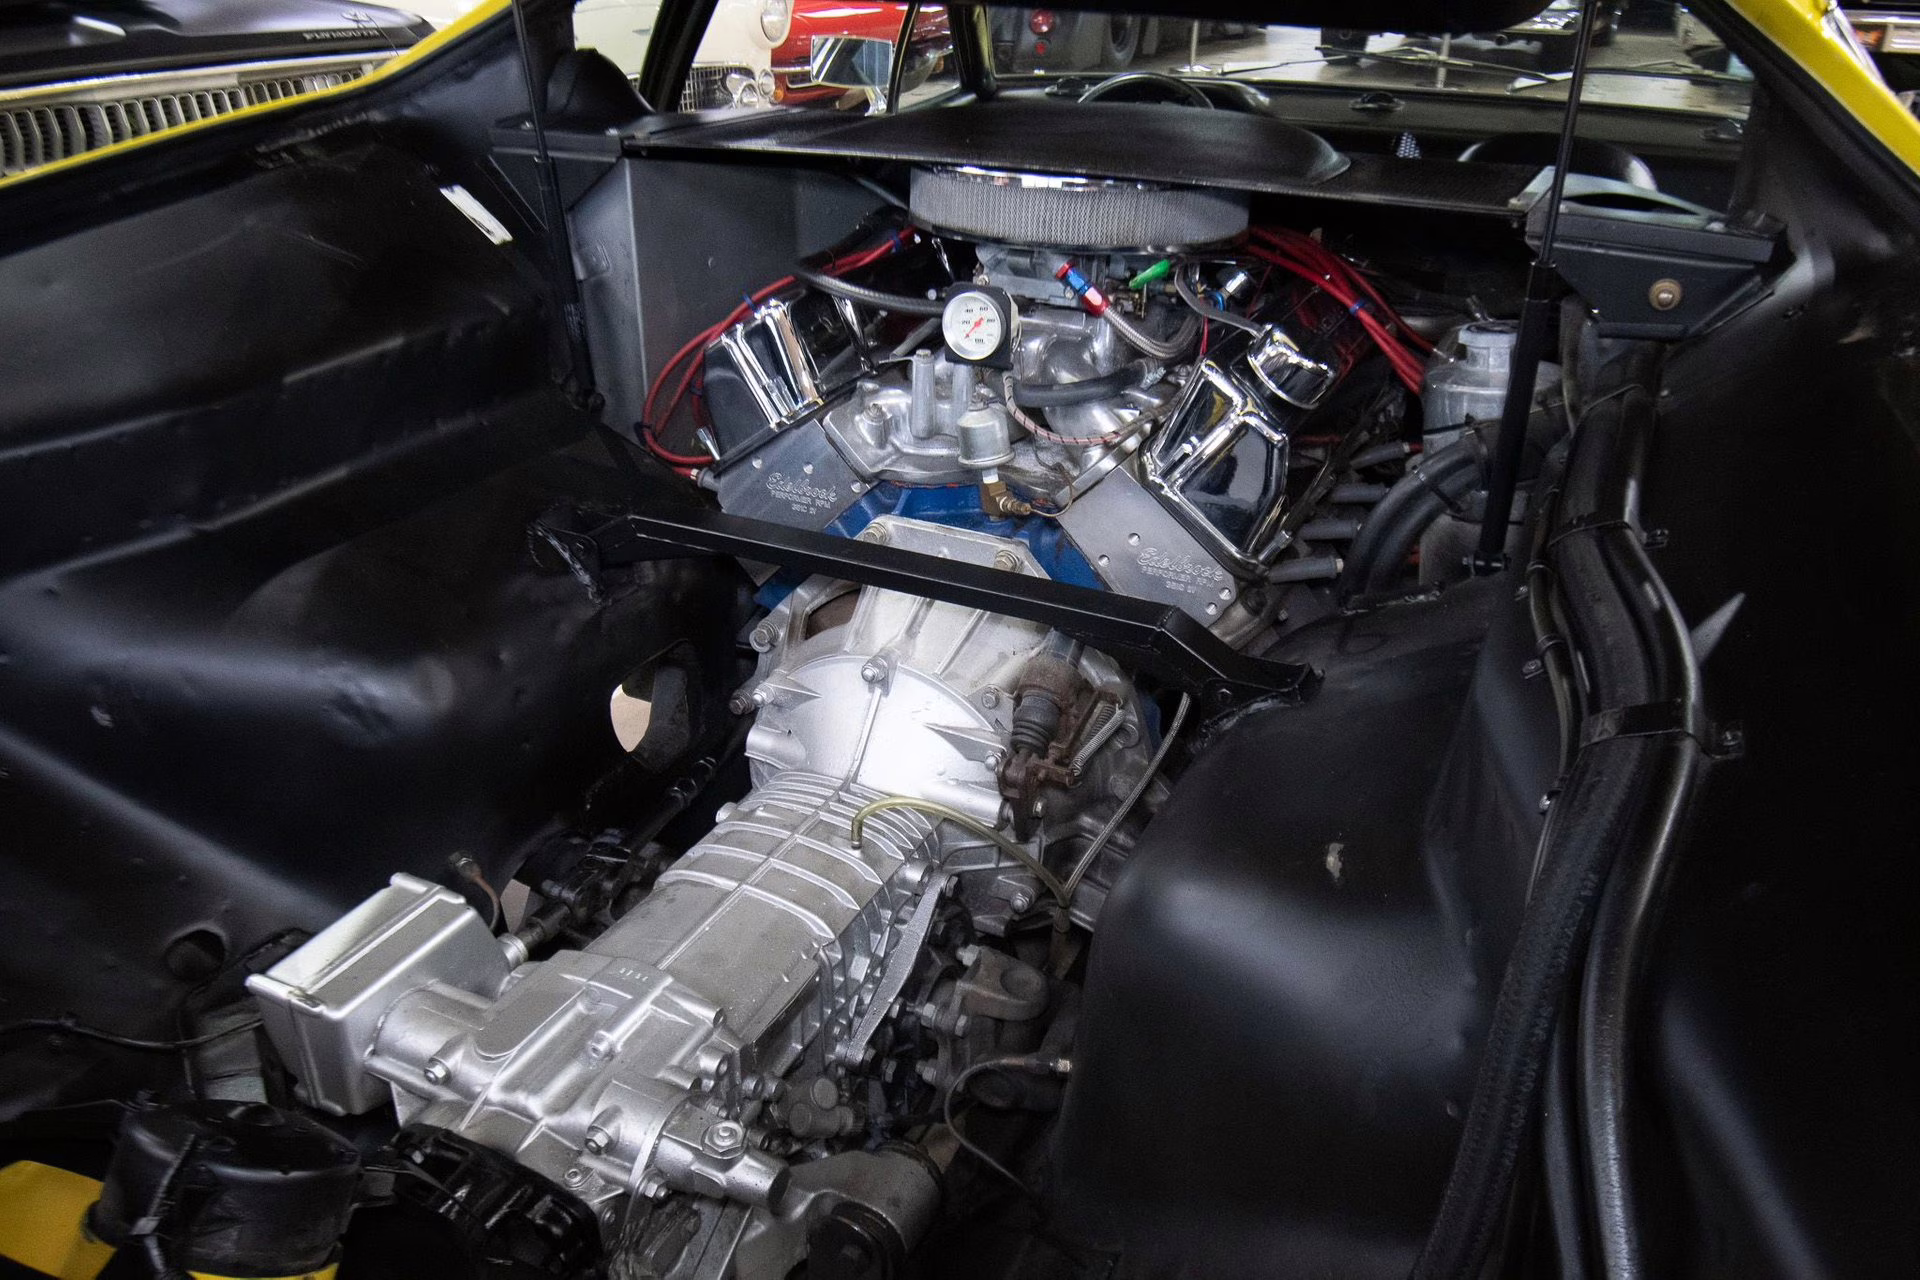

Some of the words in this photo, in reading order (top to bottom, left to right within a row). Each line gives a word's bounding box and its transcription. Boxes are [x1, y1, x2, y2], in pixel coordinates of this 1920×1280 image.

[302, 29, 380, 41] PLYMOUTH
[765, 472, 838, 503] Edelbrock
[771, 490, 812, 505] PERFORMER
[815, 499, 831, 509] RPM
[1136, 547, 1223, 582] Edelbrock
[1141, 566, 1191, 583] PERFORMER
